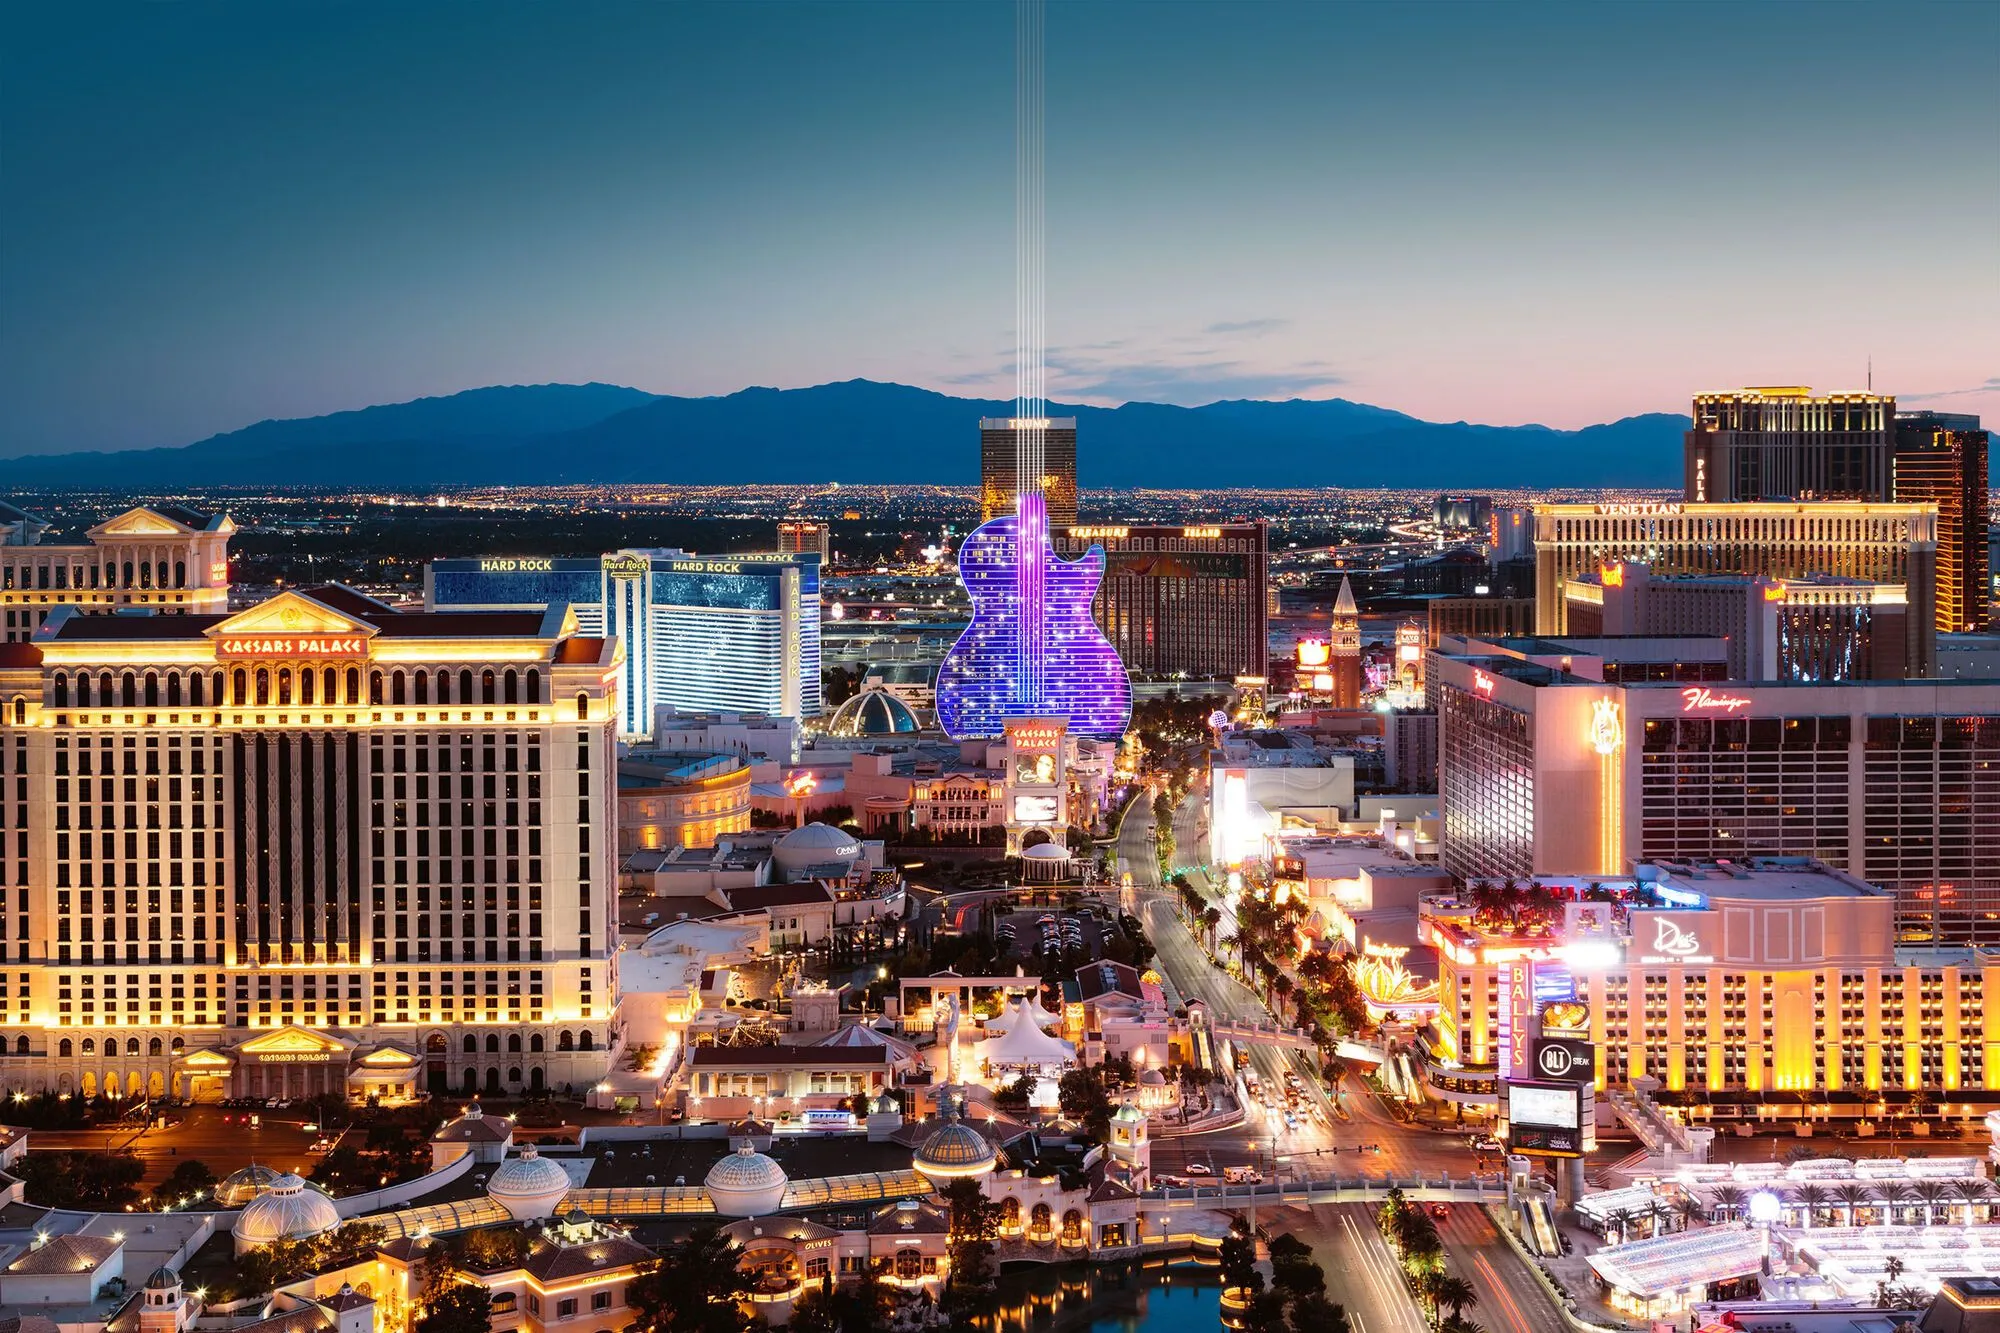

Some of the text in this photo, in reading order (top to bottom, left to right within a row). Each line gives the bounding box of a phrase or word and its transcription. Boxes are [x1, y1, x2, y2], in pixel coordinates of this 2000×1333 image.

[1009, 418, 1050, 429] TRUMP
[1599, 503, 1680, 515] VENETIAN
[1068, 528, 1222, 538] TREASURE ISLAND
[766, 554, 794, 562] ROCK
[481, 560, 552, 571] HARD ROCK
[602, 559, 647, 571] Hard Rock
[673, 562, 741, 573] HARD ROCK
[790, 575, 799, 621] HARD
[222, 639, 361, 653] CAESARS PALACE
[790, 632, 799, 677] ROCK
[1682, 687, 1752, 713] Flamingo
[1013, 729, 1059, 738] CAESARS
[1016, 739, 1057, 748] PALACE
[258, 1054, 296, 1062] CAESARS
[1546, 1050, 1590, 1069] BLT STEAK
[804, 1240, 832, 1250] OLIVES
